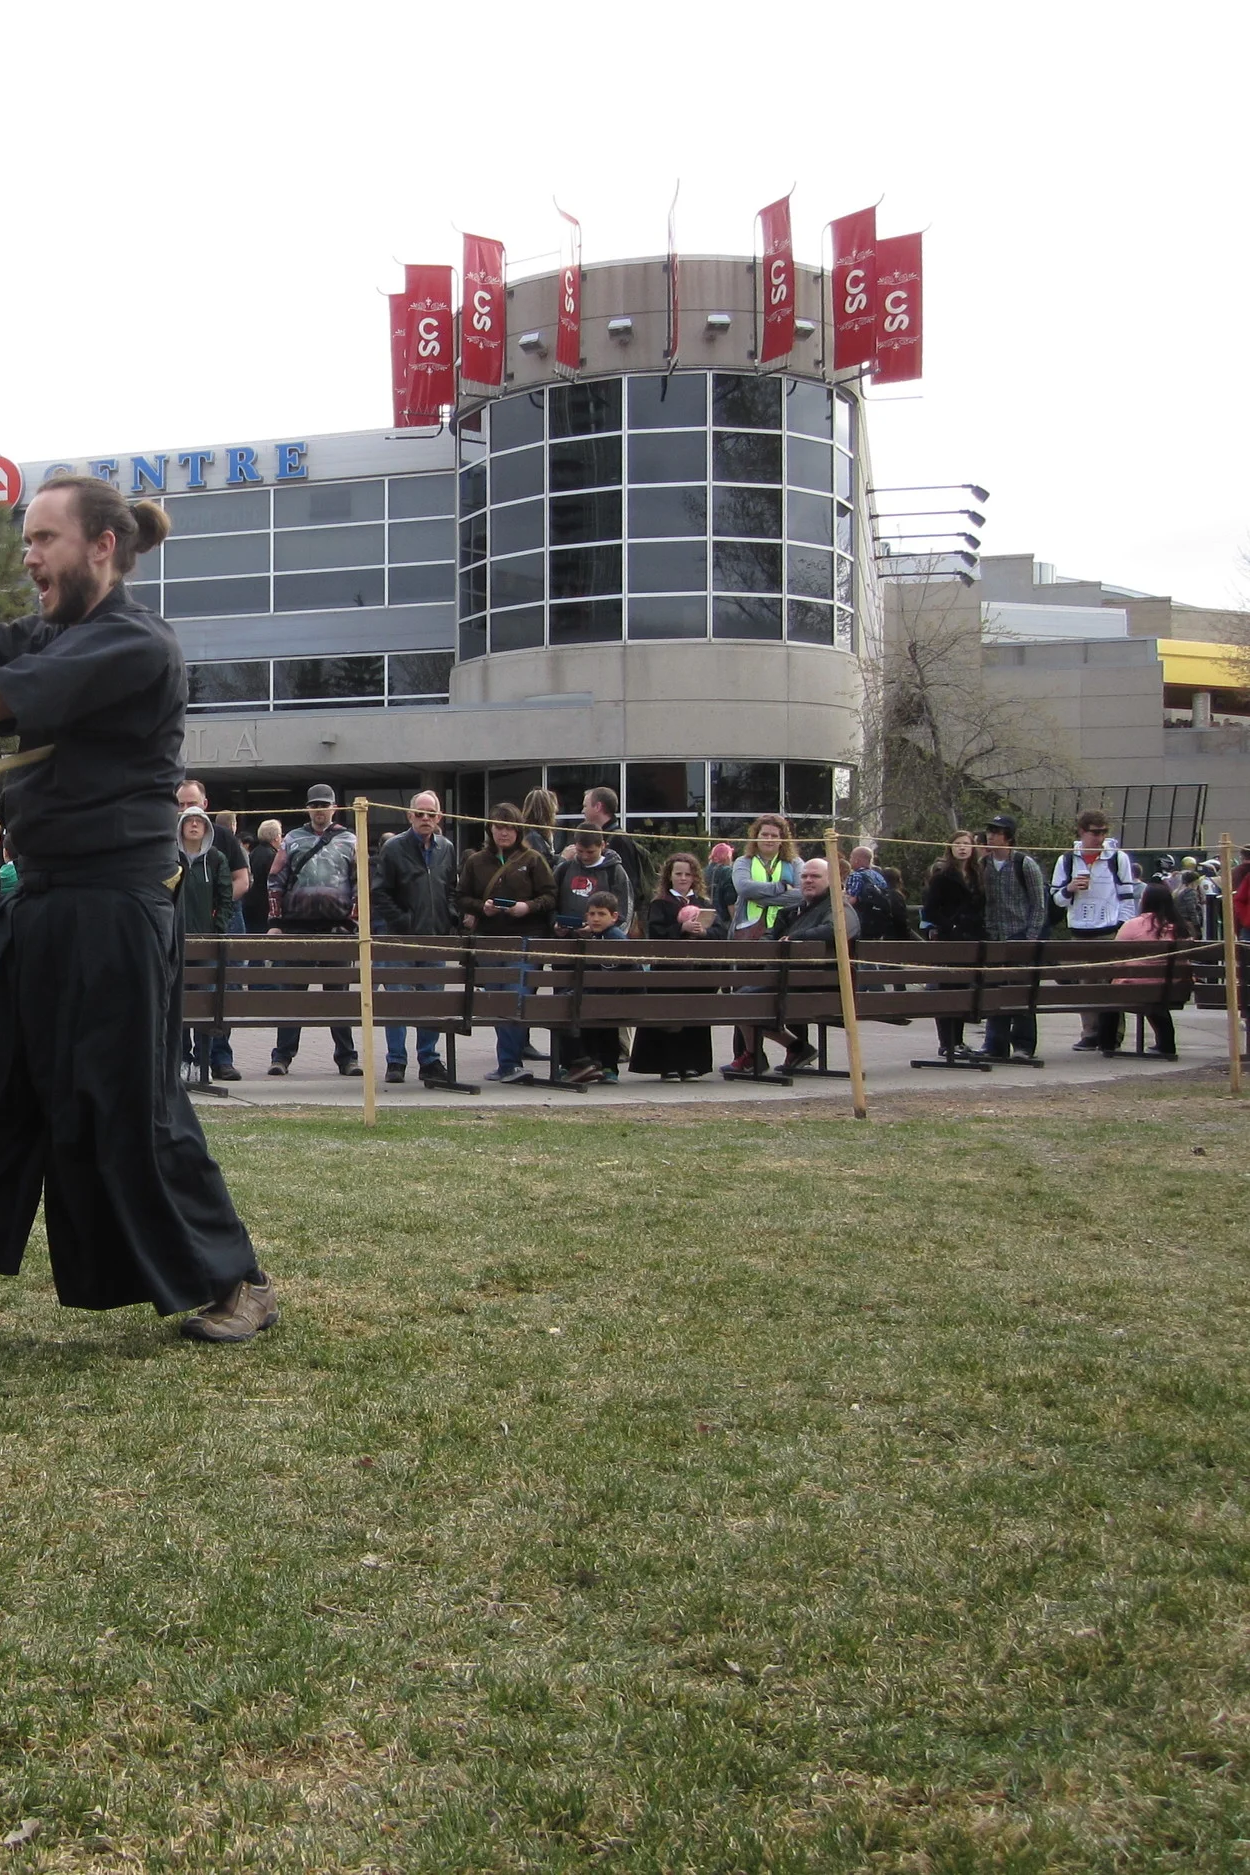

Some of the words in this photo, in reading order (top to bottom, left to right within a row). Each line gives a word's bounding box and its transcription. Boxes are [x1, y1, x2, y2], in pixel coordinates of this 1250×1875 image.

[565, 270, 574, 314] CS
[771, 260, 786, 304] CS
[845, 269, 867, 314] CS
[472, 290, 492, 332] CS
[884, 290, 909, 333] CS
[418, 317, 440, 357] CS
[182, 727, 263, 764] LA
